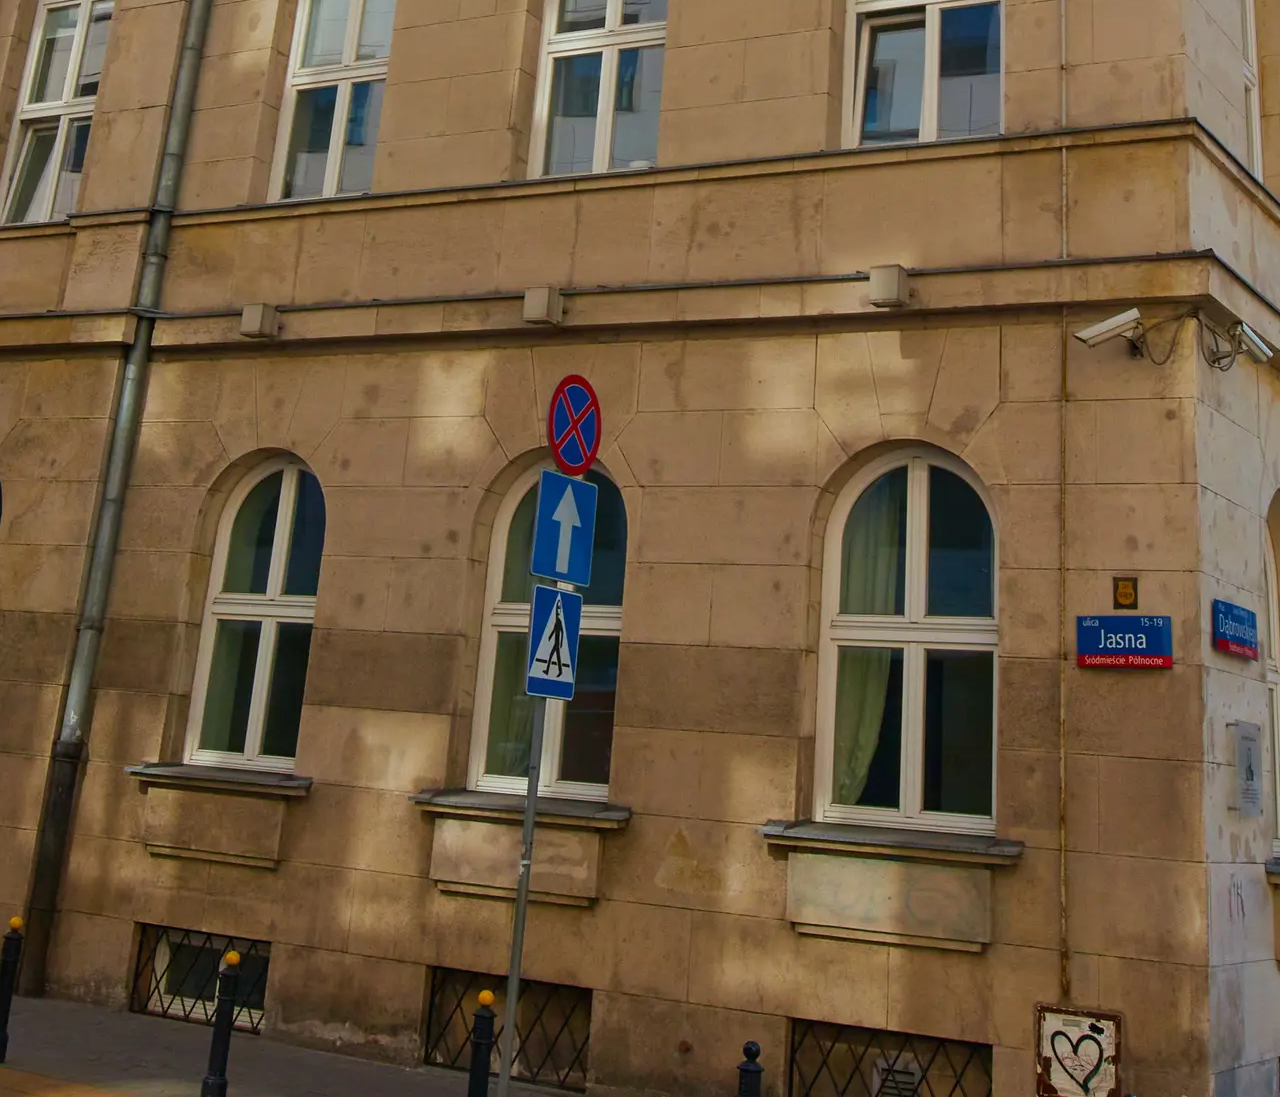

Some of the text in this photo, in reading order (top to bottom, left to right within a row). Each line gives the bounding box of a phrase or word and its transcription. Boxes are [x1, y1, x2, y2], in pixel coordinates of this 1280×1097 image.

[1083, 617, 1163, 627] ulica 15-19
[1098, 628, 1147, 649] Jasna
[1084, 654, 1163, 666] Śródmieście Północne
